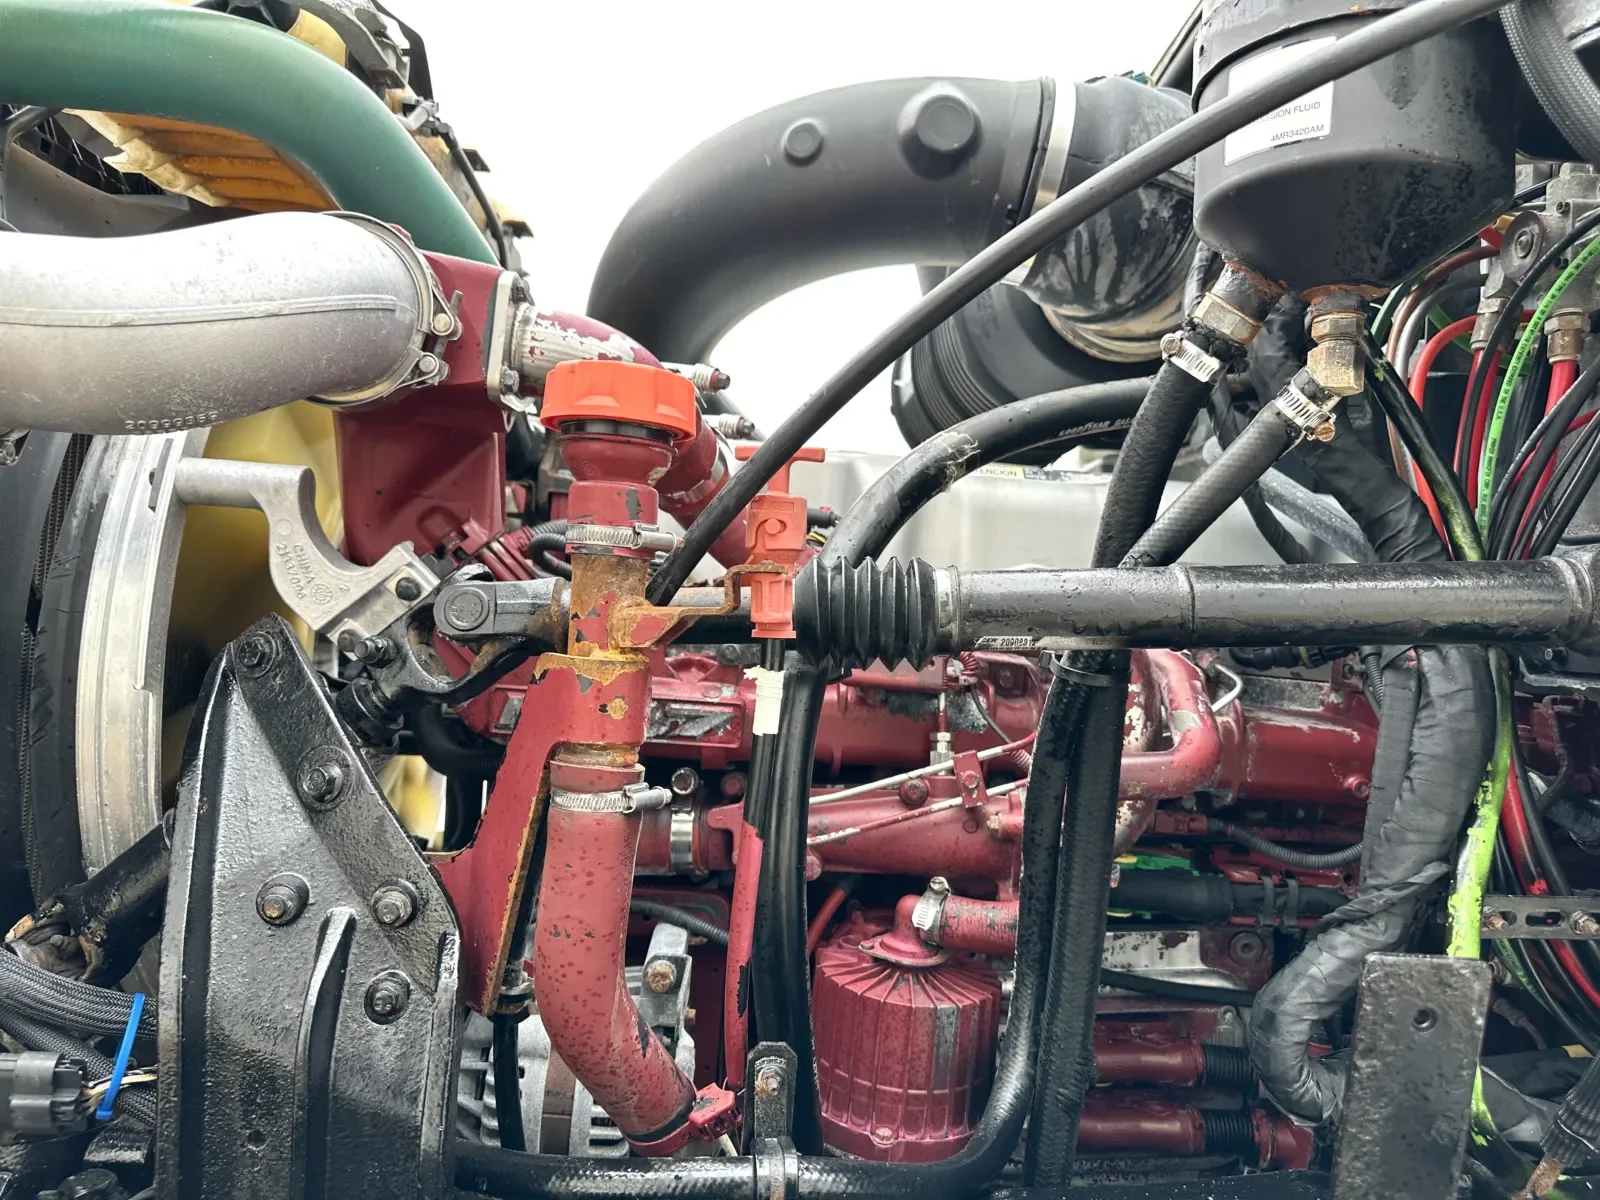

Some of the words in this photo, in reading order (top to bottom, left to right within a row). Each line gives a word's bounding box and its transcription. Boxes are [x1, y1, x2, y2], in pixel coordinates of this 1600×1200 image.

[1293, 101, 1321, 114] FLUID
[1271, 125, 1324, 141] 4MR3420AM
[292, 544, 316, 585] CHINA
